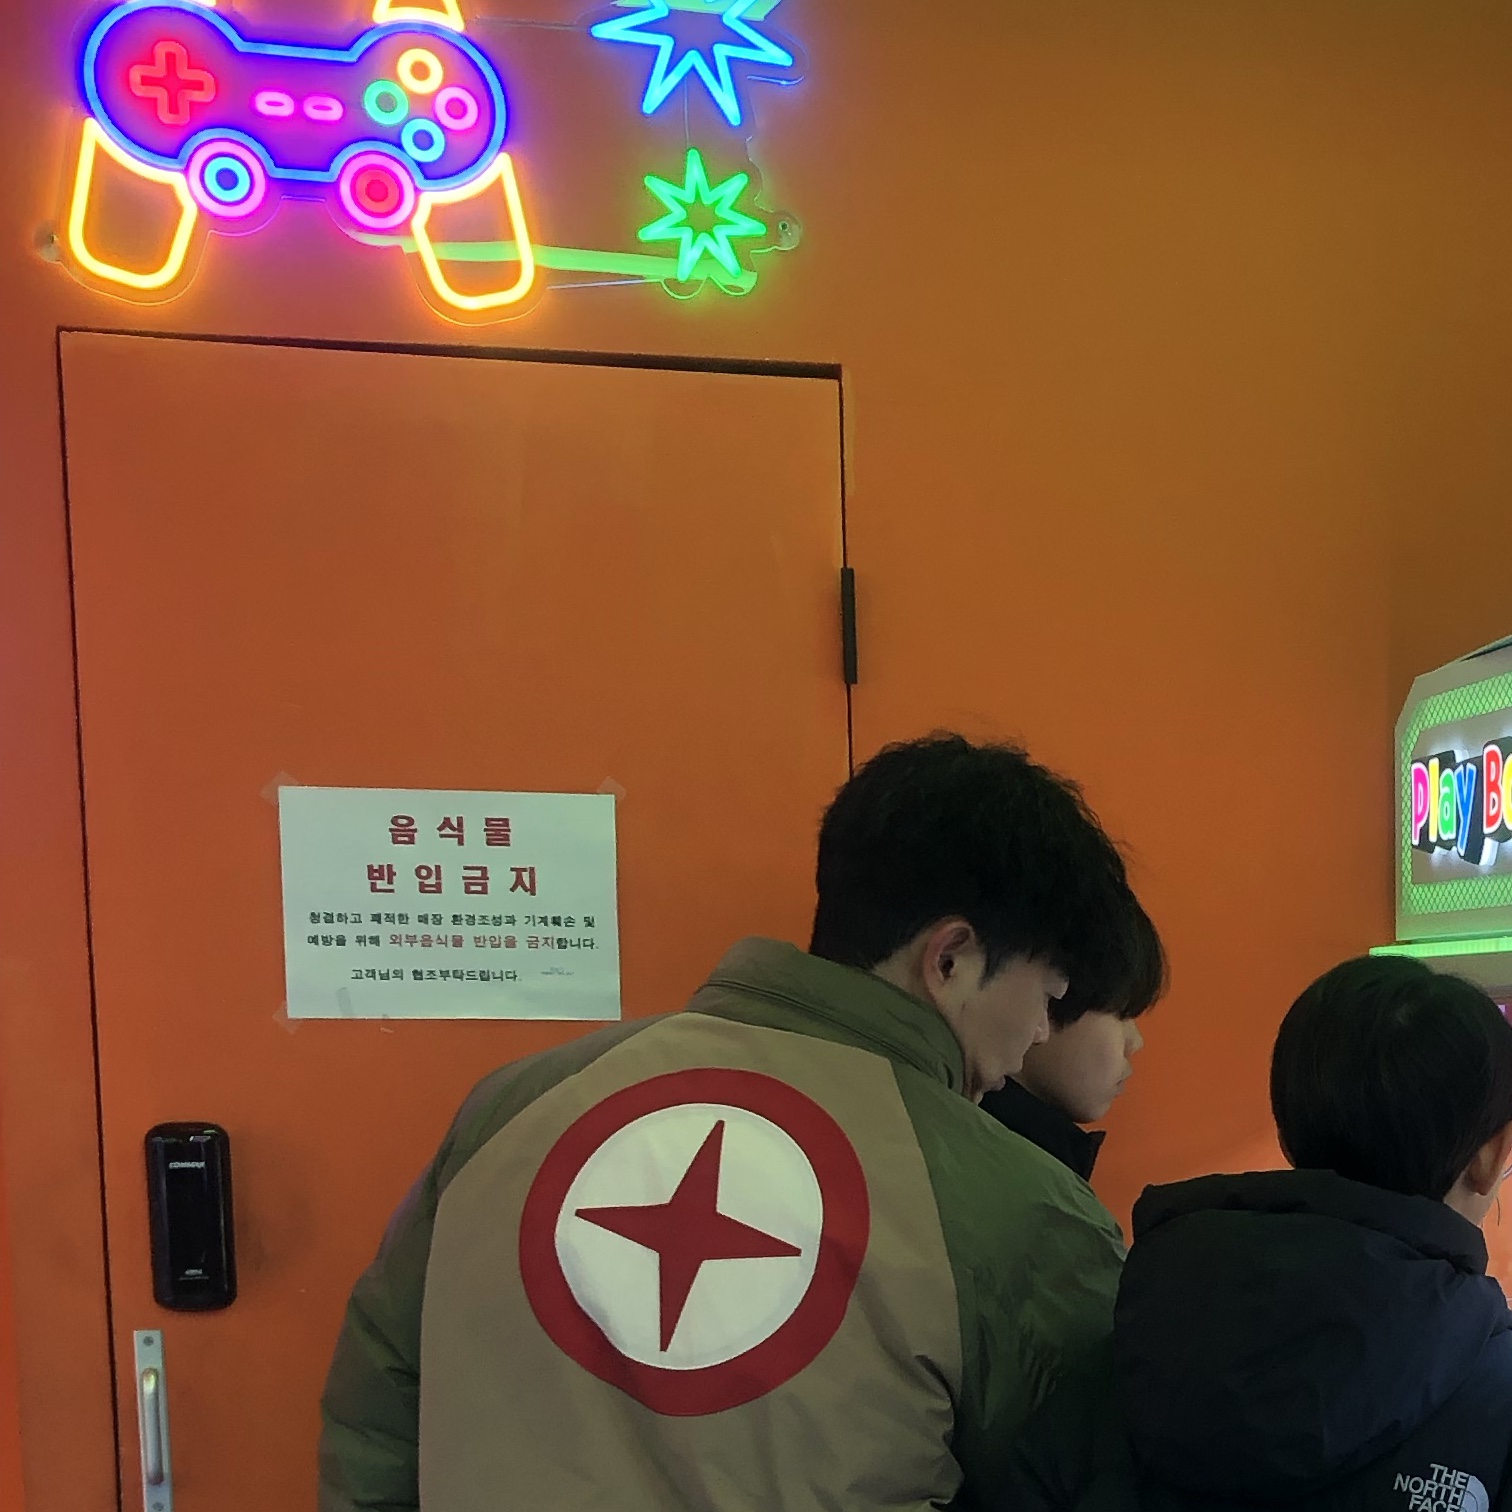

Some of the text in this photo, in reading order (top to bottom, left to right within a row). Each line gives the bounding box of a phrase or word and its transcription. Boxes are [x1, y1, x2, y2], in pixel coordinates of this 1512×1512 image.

[1411, 757, 1477, 857] Play
[309, 911, 362, 925] 청결하고
[418, 912, 443, 926] 매장
[451, 913, 517, 927] 환경조성과
[583, 915, 596, 929] 및
[307, 934, 347, 948] 예방을
[355, 934, 381, 948] 위해
[389, 933, 464, 948] 외부음식물
[473, 934, 518, 950] 반입을
[351, 968, 404, 982] 고객님의
[1430, 1463, 1469, 1490] THE
[1393, 1473, 1465, 1506] NORTH
